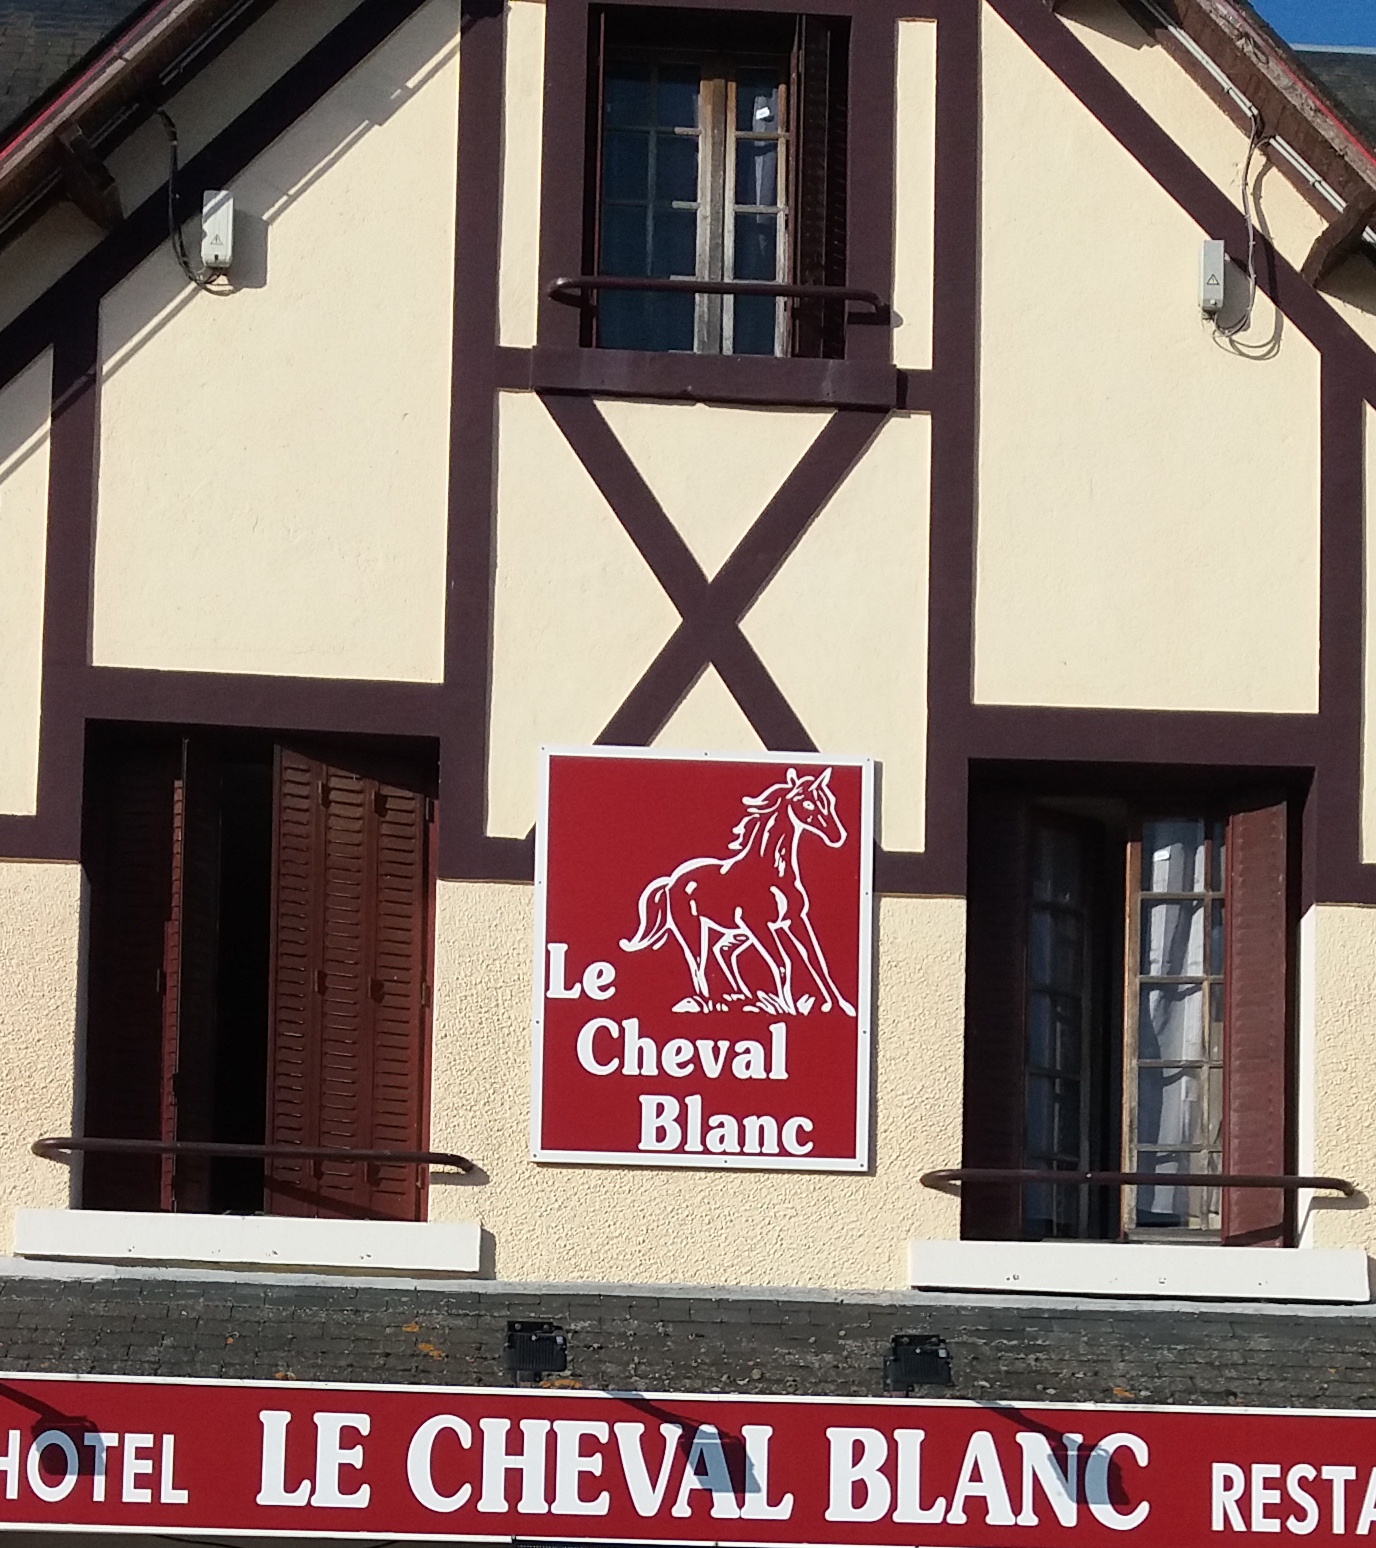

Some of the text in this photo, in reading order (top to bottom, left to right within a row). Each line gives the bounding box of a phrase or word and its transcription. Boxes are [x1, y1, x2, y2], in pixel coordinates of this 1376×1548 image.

[546, 942, 616, 1001] Le
[576, 1017, 789, 1080] Cheval
[637, 1093, 814, 1156] Blanc
[255, 1409, 371, 1509] LE
[406, 1414, 794, 1521] CHEVAL
[824, 1426, 1150, 1531] BLANC
